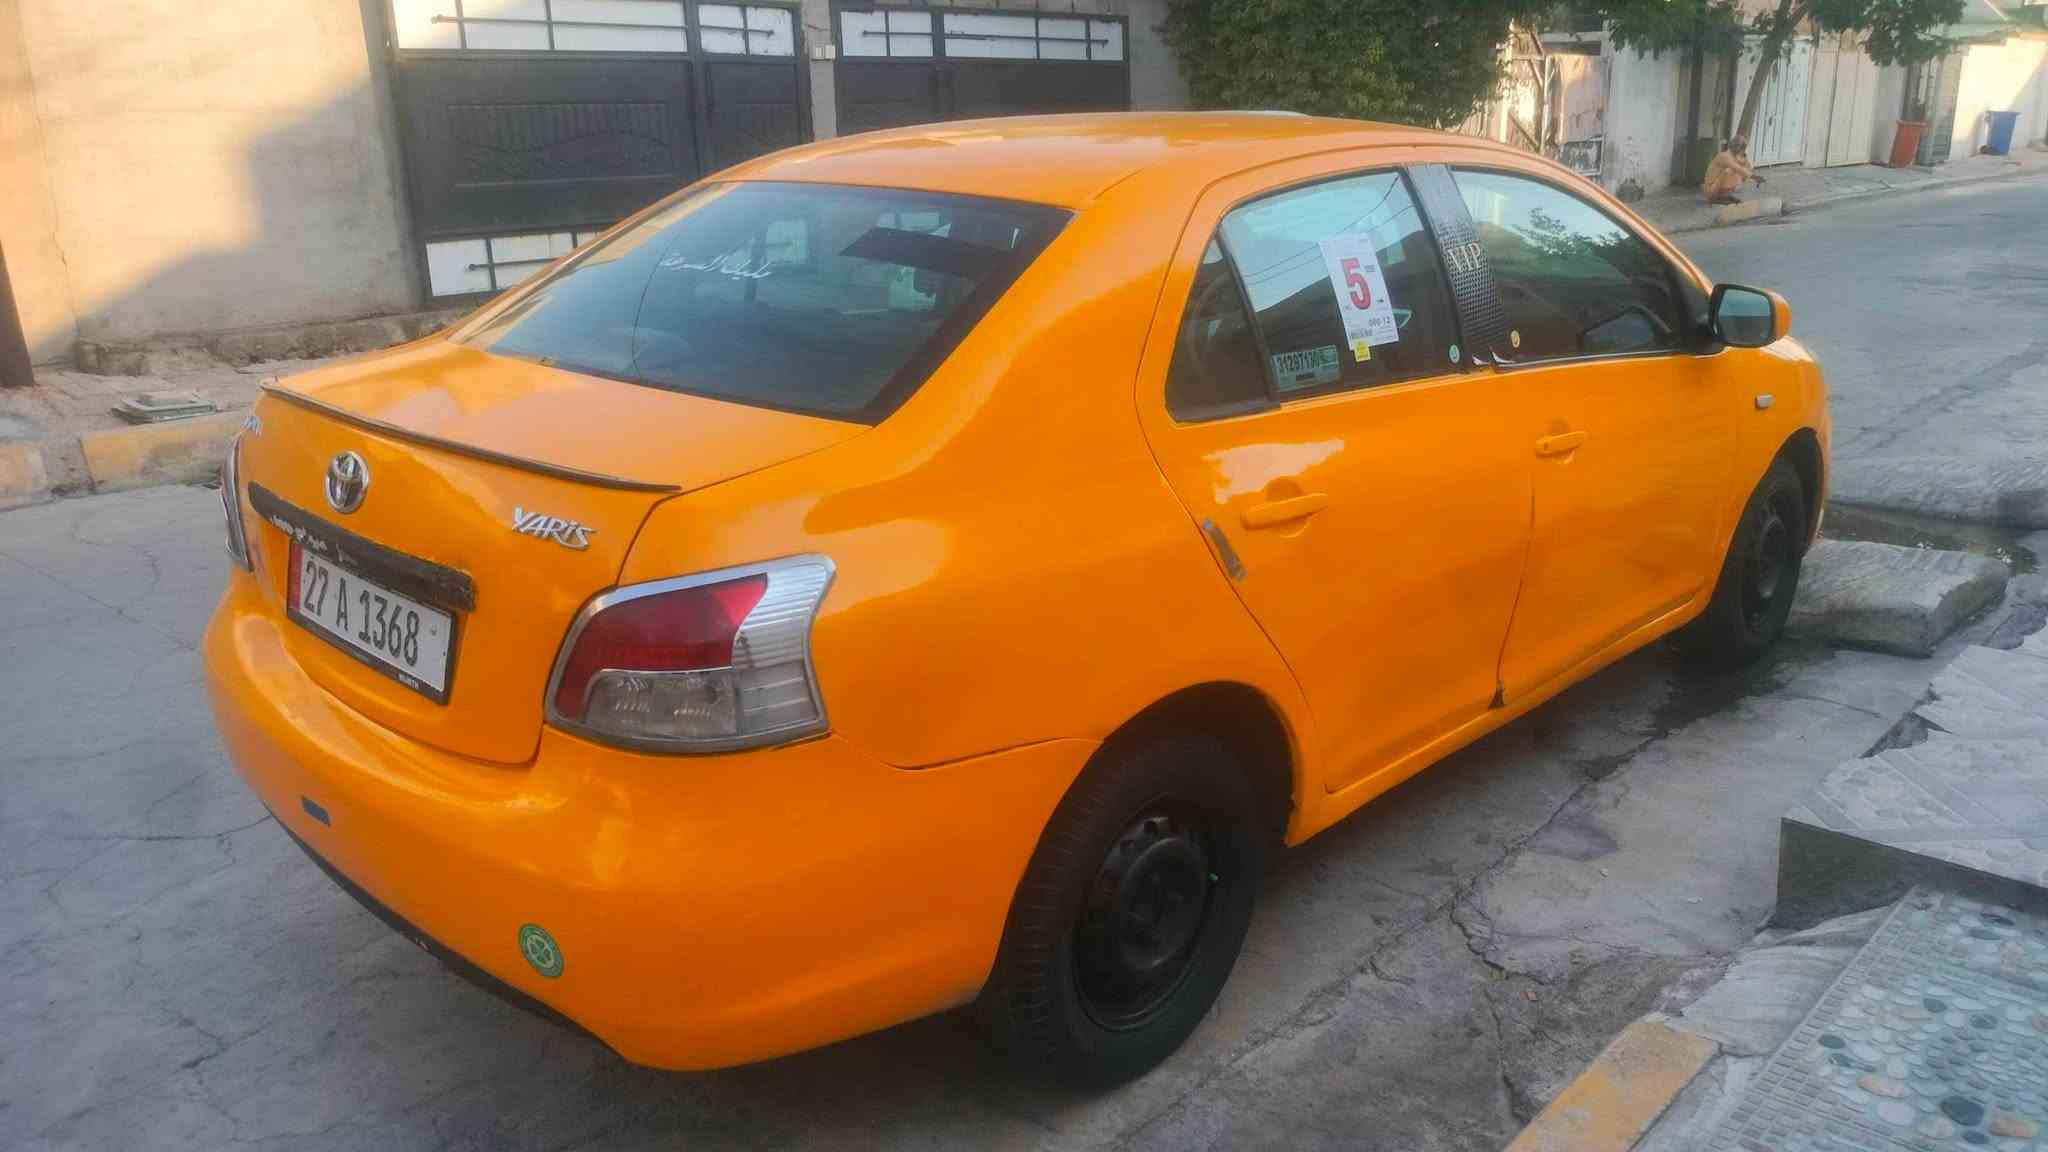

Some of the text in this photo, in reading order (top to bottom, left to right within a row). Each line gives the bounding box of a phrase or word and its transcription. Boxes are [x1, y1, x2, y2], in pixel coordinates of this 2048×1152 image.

[1342, 257, 1371, 309] 5
[1447, 243, 1482, 273] VIP
[304, 560, 420, 667] 27 A 1368
